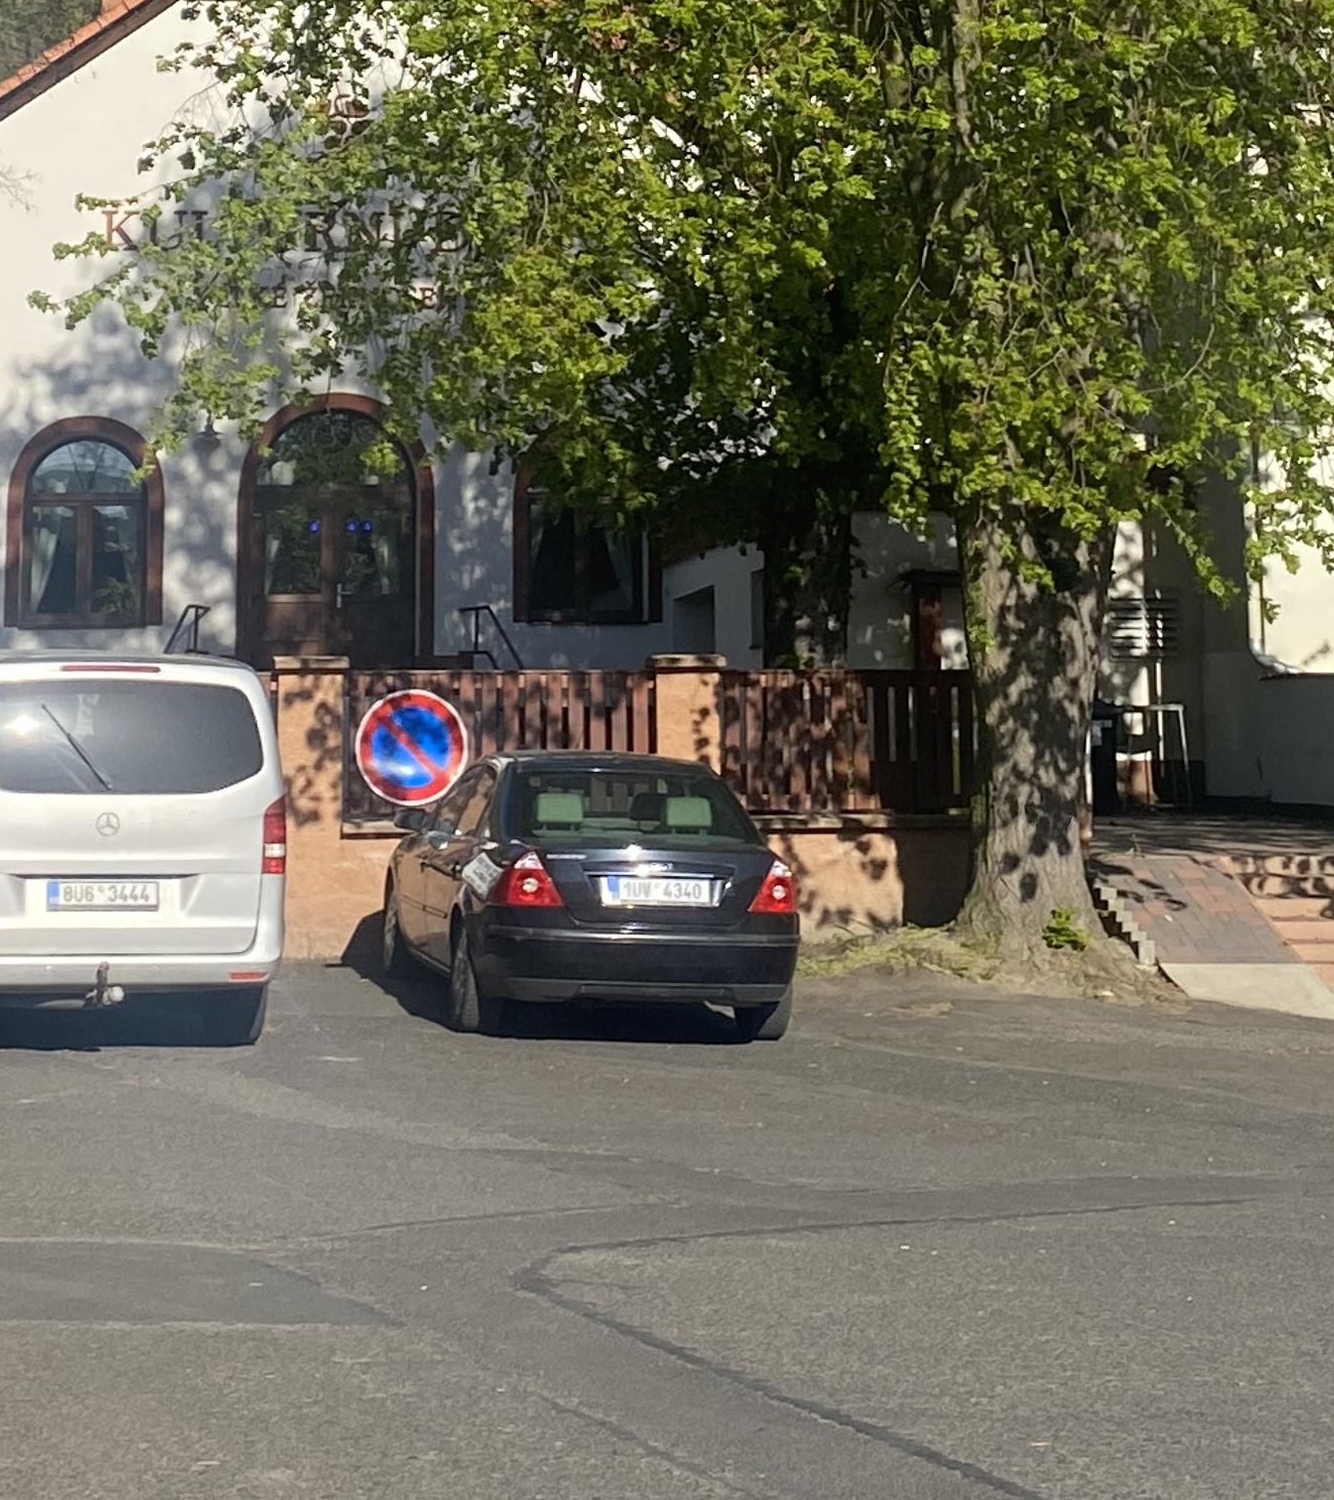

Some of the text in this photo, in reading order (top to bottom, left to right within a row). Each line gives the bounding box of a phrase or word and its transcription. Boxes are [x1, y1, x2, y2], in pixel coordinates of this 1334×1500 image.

[63, 885, 149, 902] 8U6 3444
[623, 882, 703, 900] 1UV 4340
